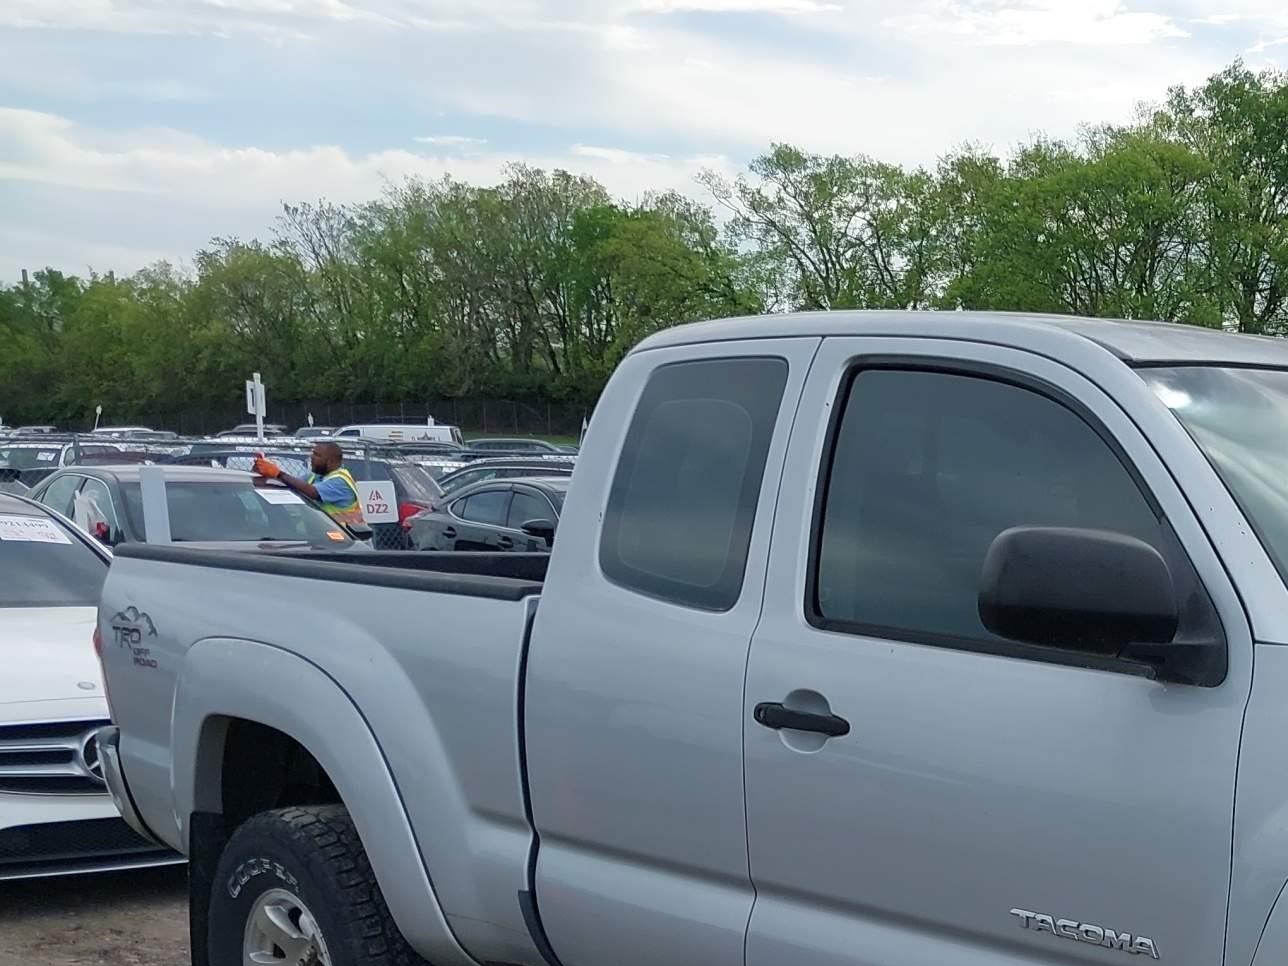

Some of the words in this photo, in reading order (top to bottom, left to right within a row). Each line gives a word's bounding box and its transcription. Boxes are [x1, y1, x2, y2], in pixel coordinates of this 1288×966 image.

[366, 503, 389, 514] DZ2
[112, 625, 142, 650] TRD
[132, 647, 151, 658] OFF
[133, 656, 158, 669] ROAD
[1009, 907, 1161, 960] TACOMA
